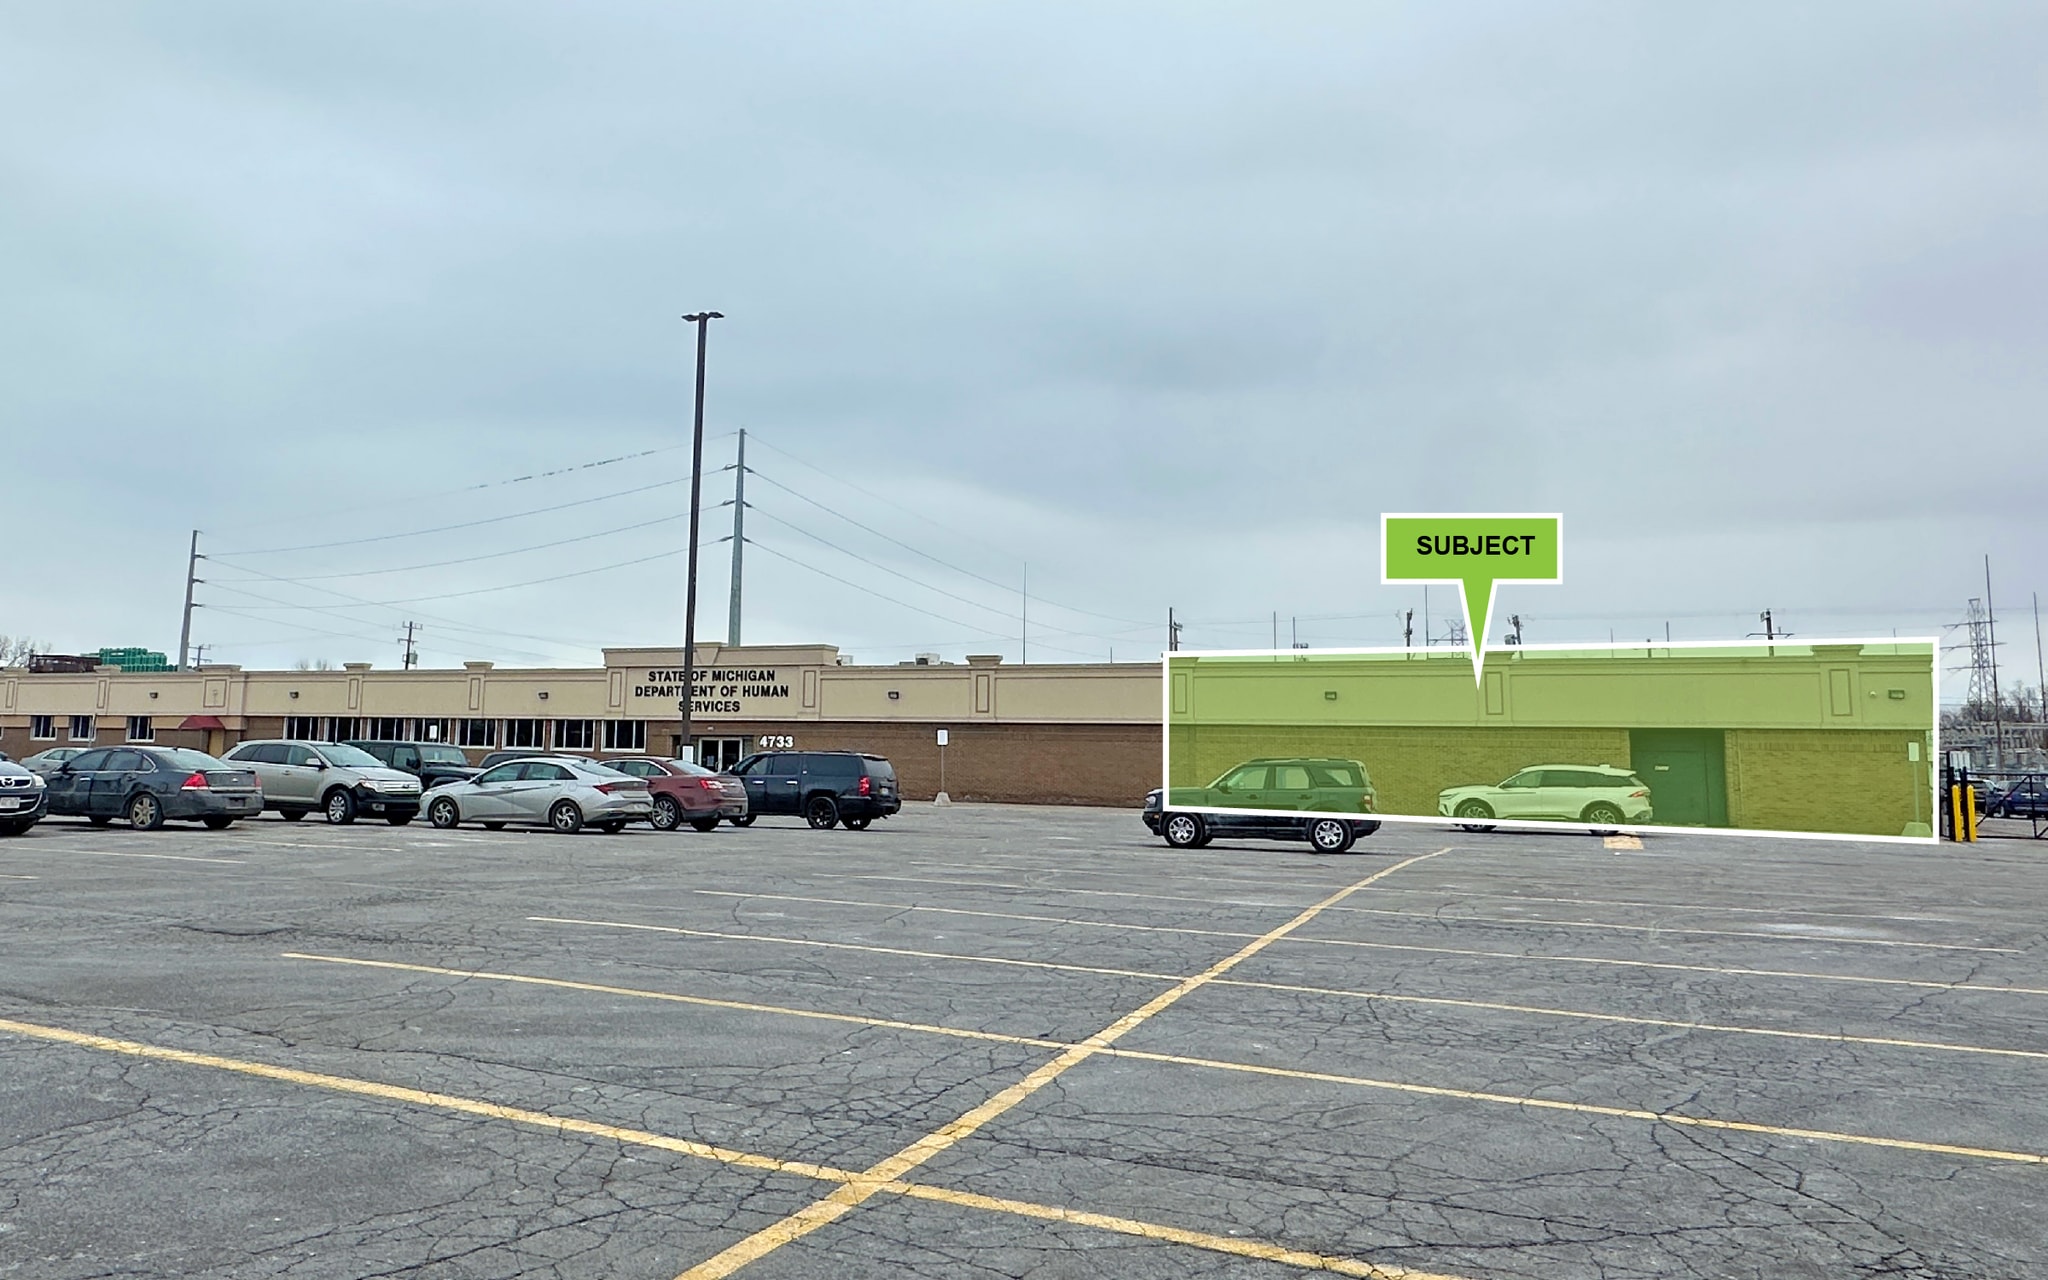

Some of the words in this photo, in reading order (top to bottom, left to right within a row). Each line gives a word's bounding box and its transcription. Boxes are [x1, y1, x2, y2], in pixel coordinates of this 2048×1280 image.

[648, 671, 685, 682] STATE
[691, 670, 707, 681] OF
[712, 670, 775, 682] MICHIGAN
[635, 685, 716, 697] DEPARTENT
[720, 685, 738, 697] OF
[742, 685, 789, 697] HUMAN
[759, 735, 794, 748] 4733
